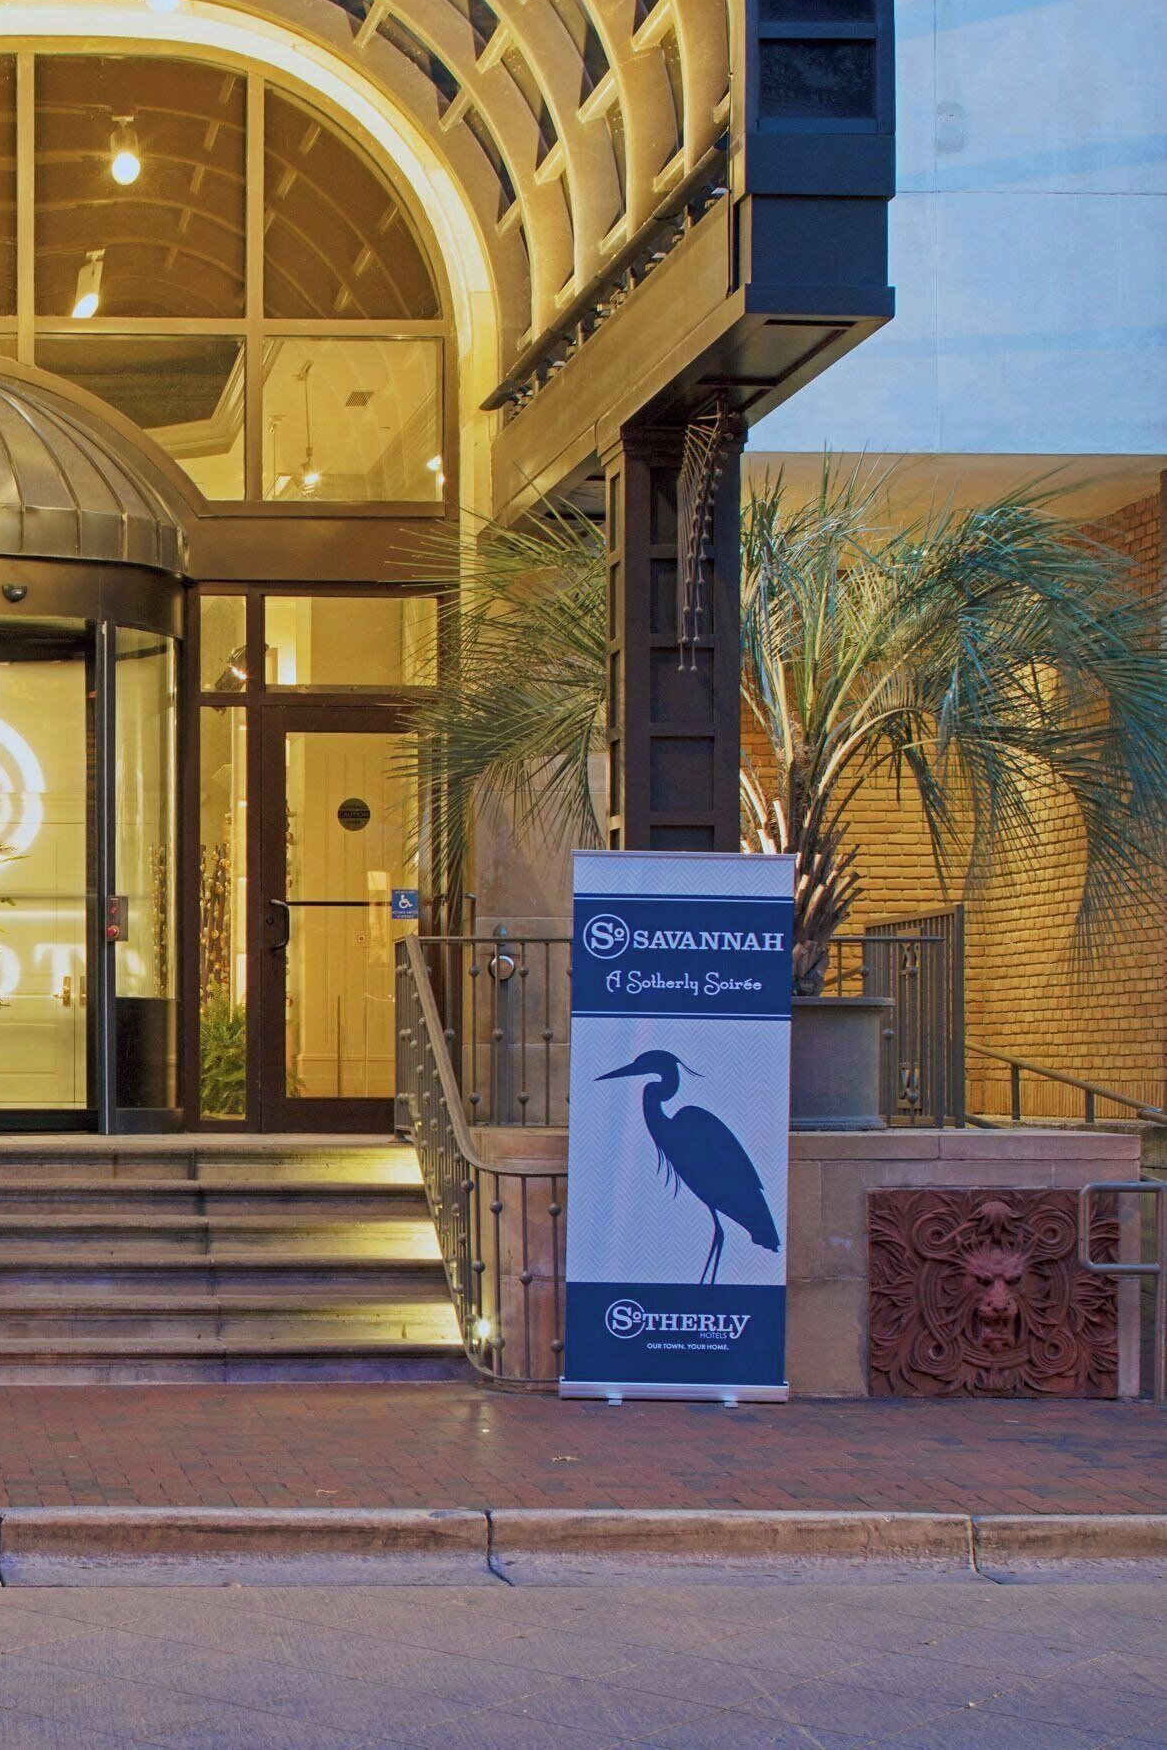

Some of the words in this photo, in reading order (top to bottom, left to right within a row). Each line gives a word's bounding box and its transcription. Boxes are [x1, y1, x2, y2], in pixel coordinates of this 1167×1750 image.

[633, 930, 784, 951] SAVANNAH
[606, 970, 622, 993] A
[626, 970, 699, 996] Sotherly
[703, 971, 762, 996] Soirée
